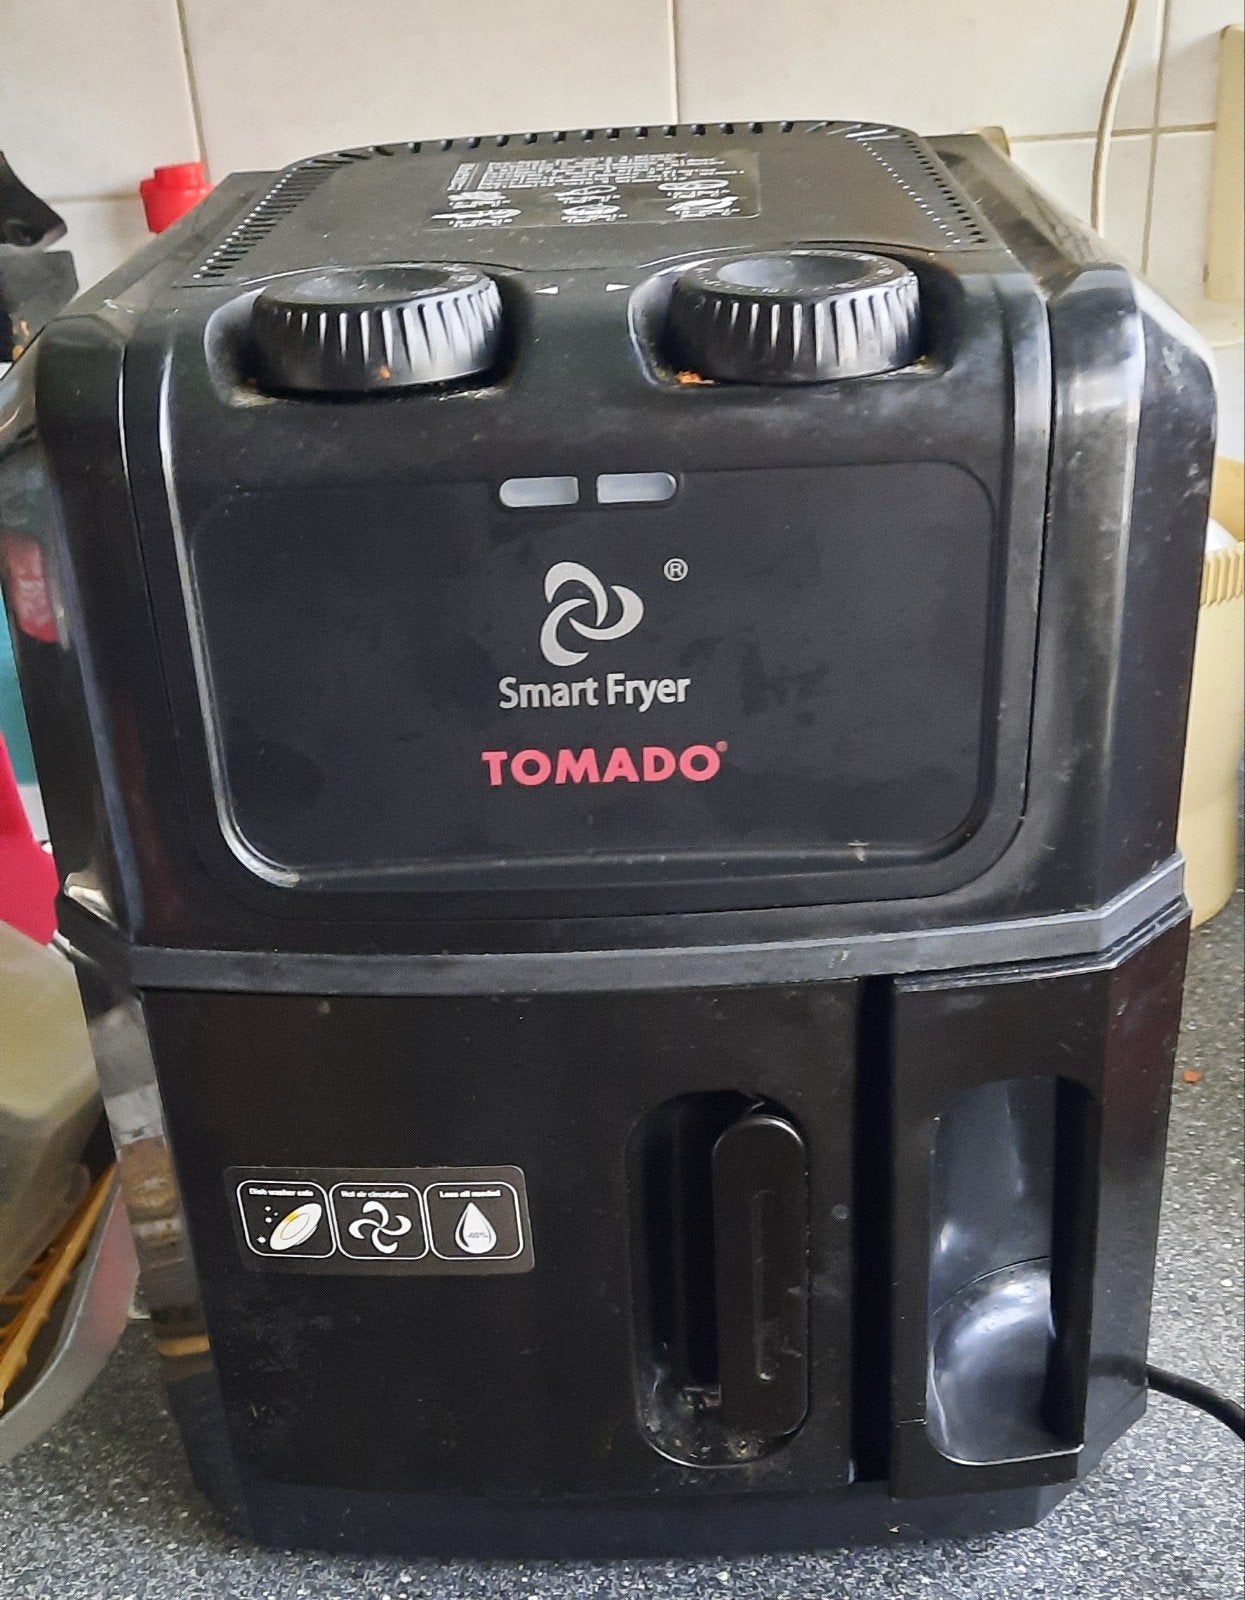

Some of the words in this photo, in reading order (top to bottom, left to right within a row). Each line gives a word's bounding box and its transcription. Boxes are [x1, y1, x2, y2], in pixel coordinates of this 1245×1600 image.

[499, 676, 599, 709] Smart
[606, 673, 692, 713] Fryer
[481, 744, 721, 786] TOMADO
